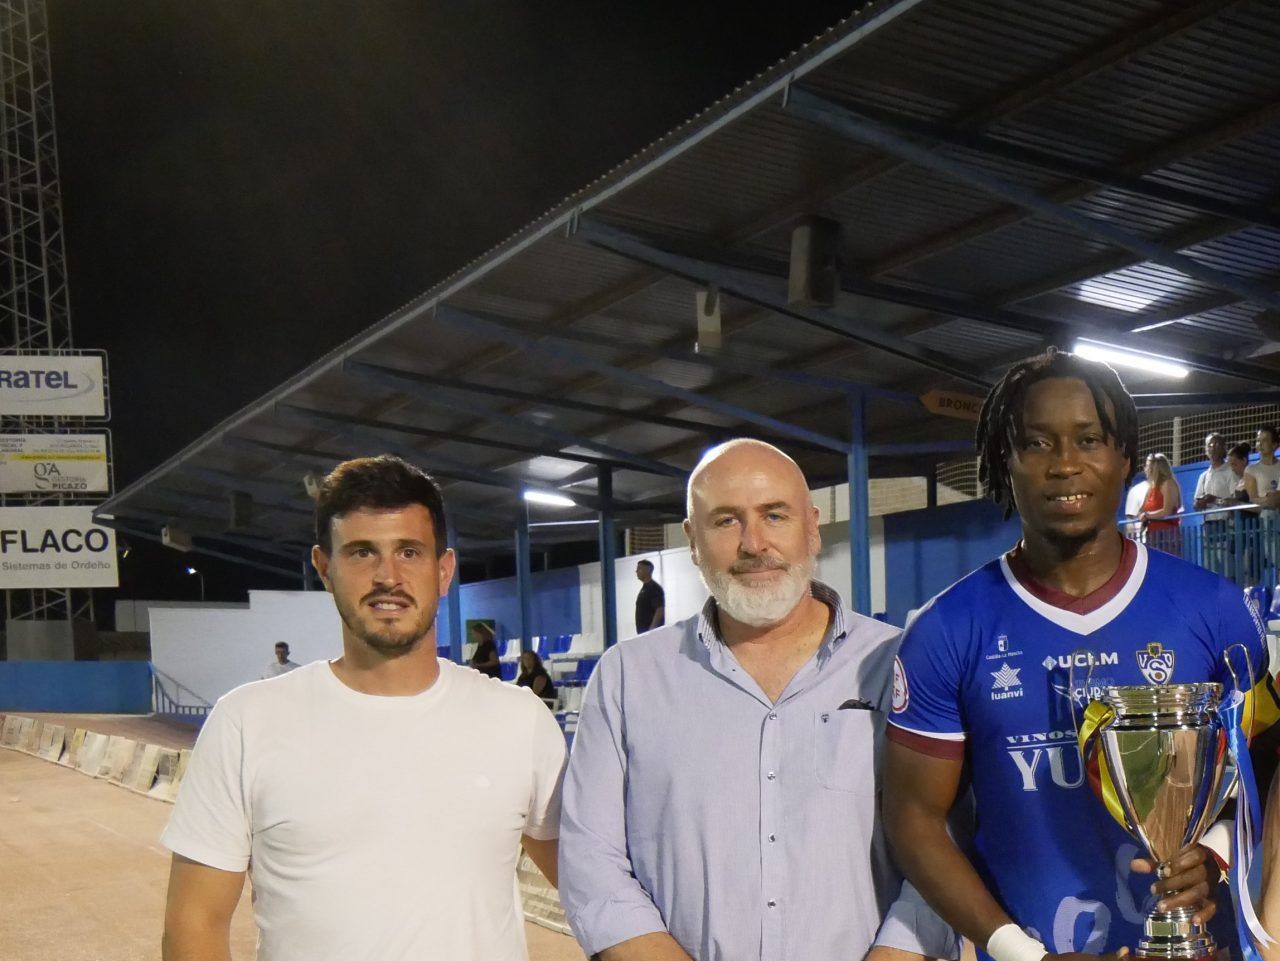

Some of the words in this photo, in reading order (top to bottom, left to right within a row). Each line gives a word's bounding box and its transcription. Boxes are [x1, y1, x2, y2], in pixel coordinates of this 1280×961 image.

[937, 396, 979, 414] BRONC
[53, 482, 88, 490] PICAZO
[0, 528, 109, 553] FLACO
[1, 561, 51, 571] Sistemas
[55, 562, 68, 570] de
[991, 687, 1024, 700] luanvi
[1006, 729, 1078, 743] VINOS
[1007, 745, 1086, 792] YU
